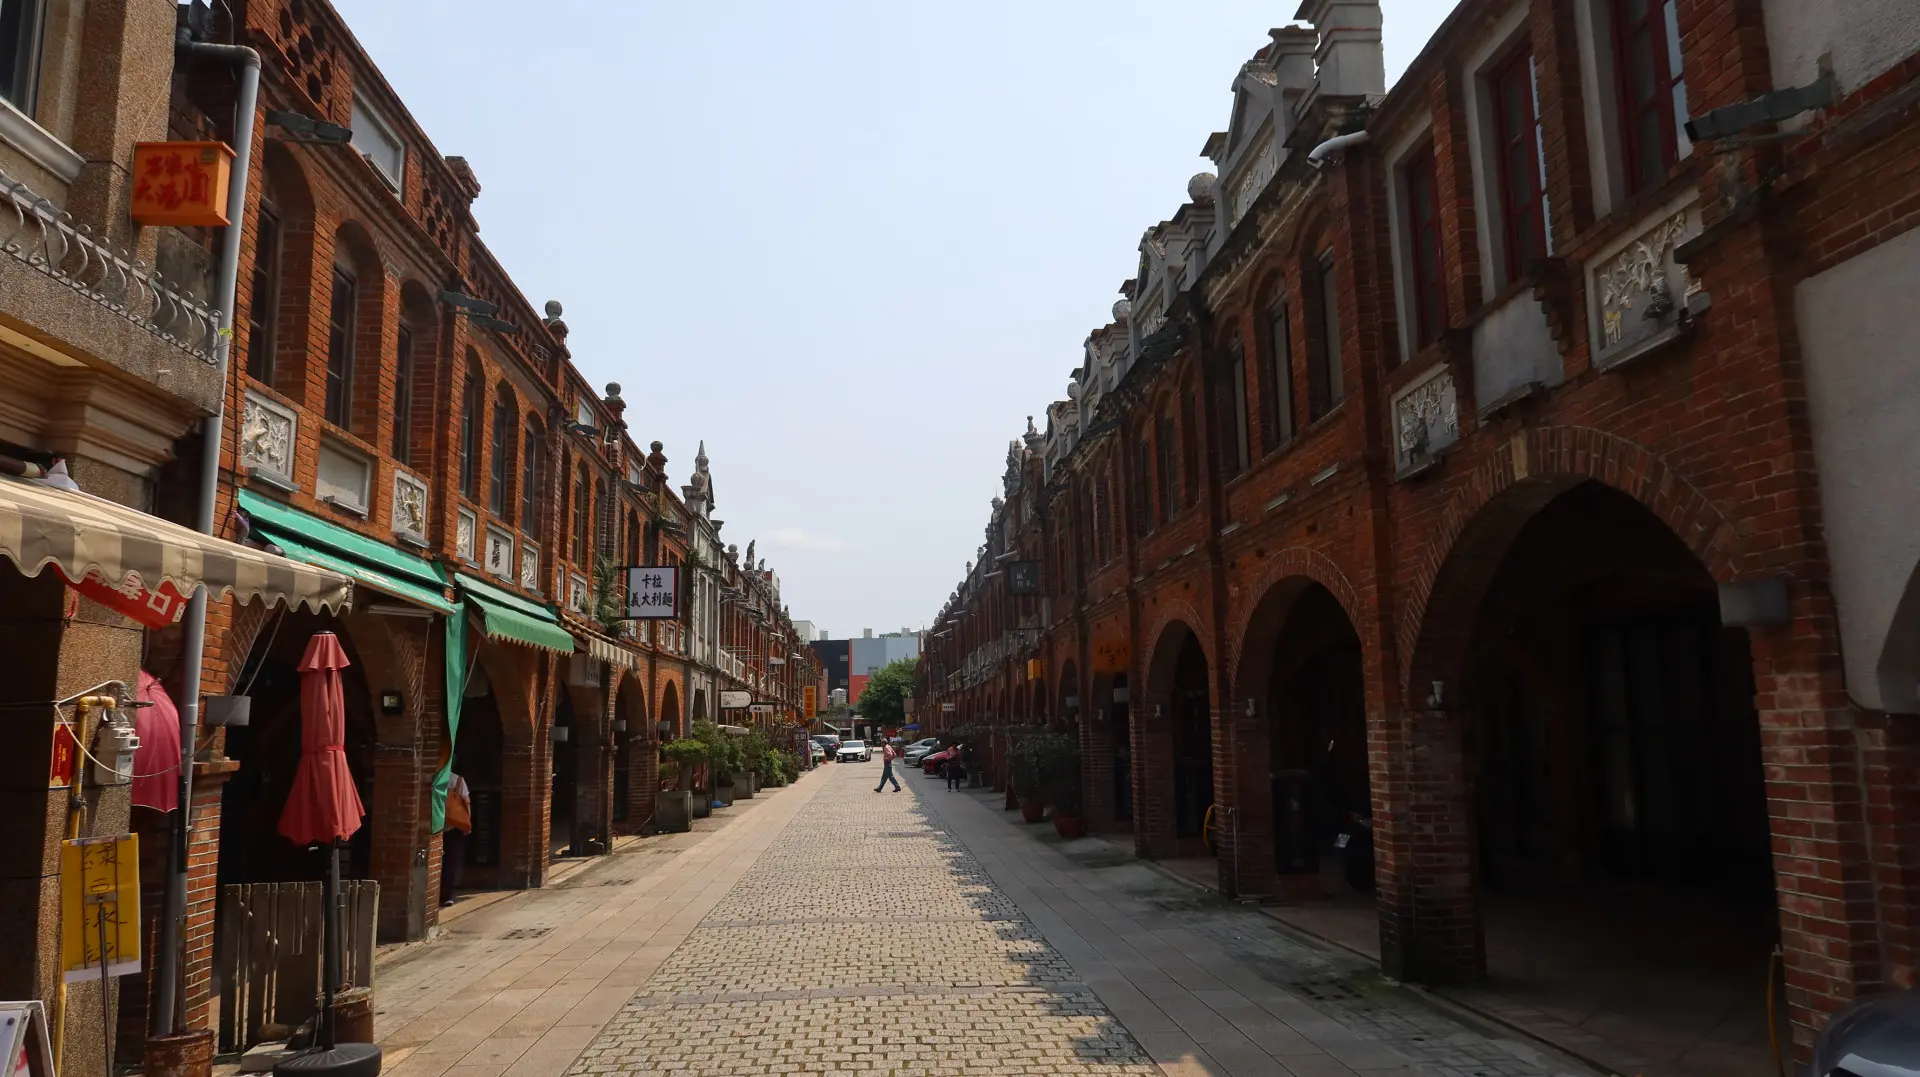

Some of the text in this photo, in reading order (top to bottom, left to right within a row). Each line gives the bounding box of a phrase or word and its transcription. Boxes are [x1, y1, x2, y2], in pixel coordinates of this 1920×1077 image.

[641, 573, 663, 589] 卡拉
[630, 591, 673, 607] 義大利麵
